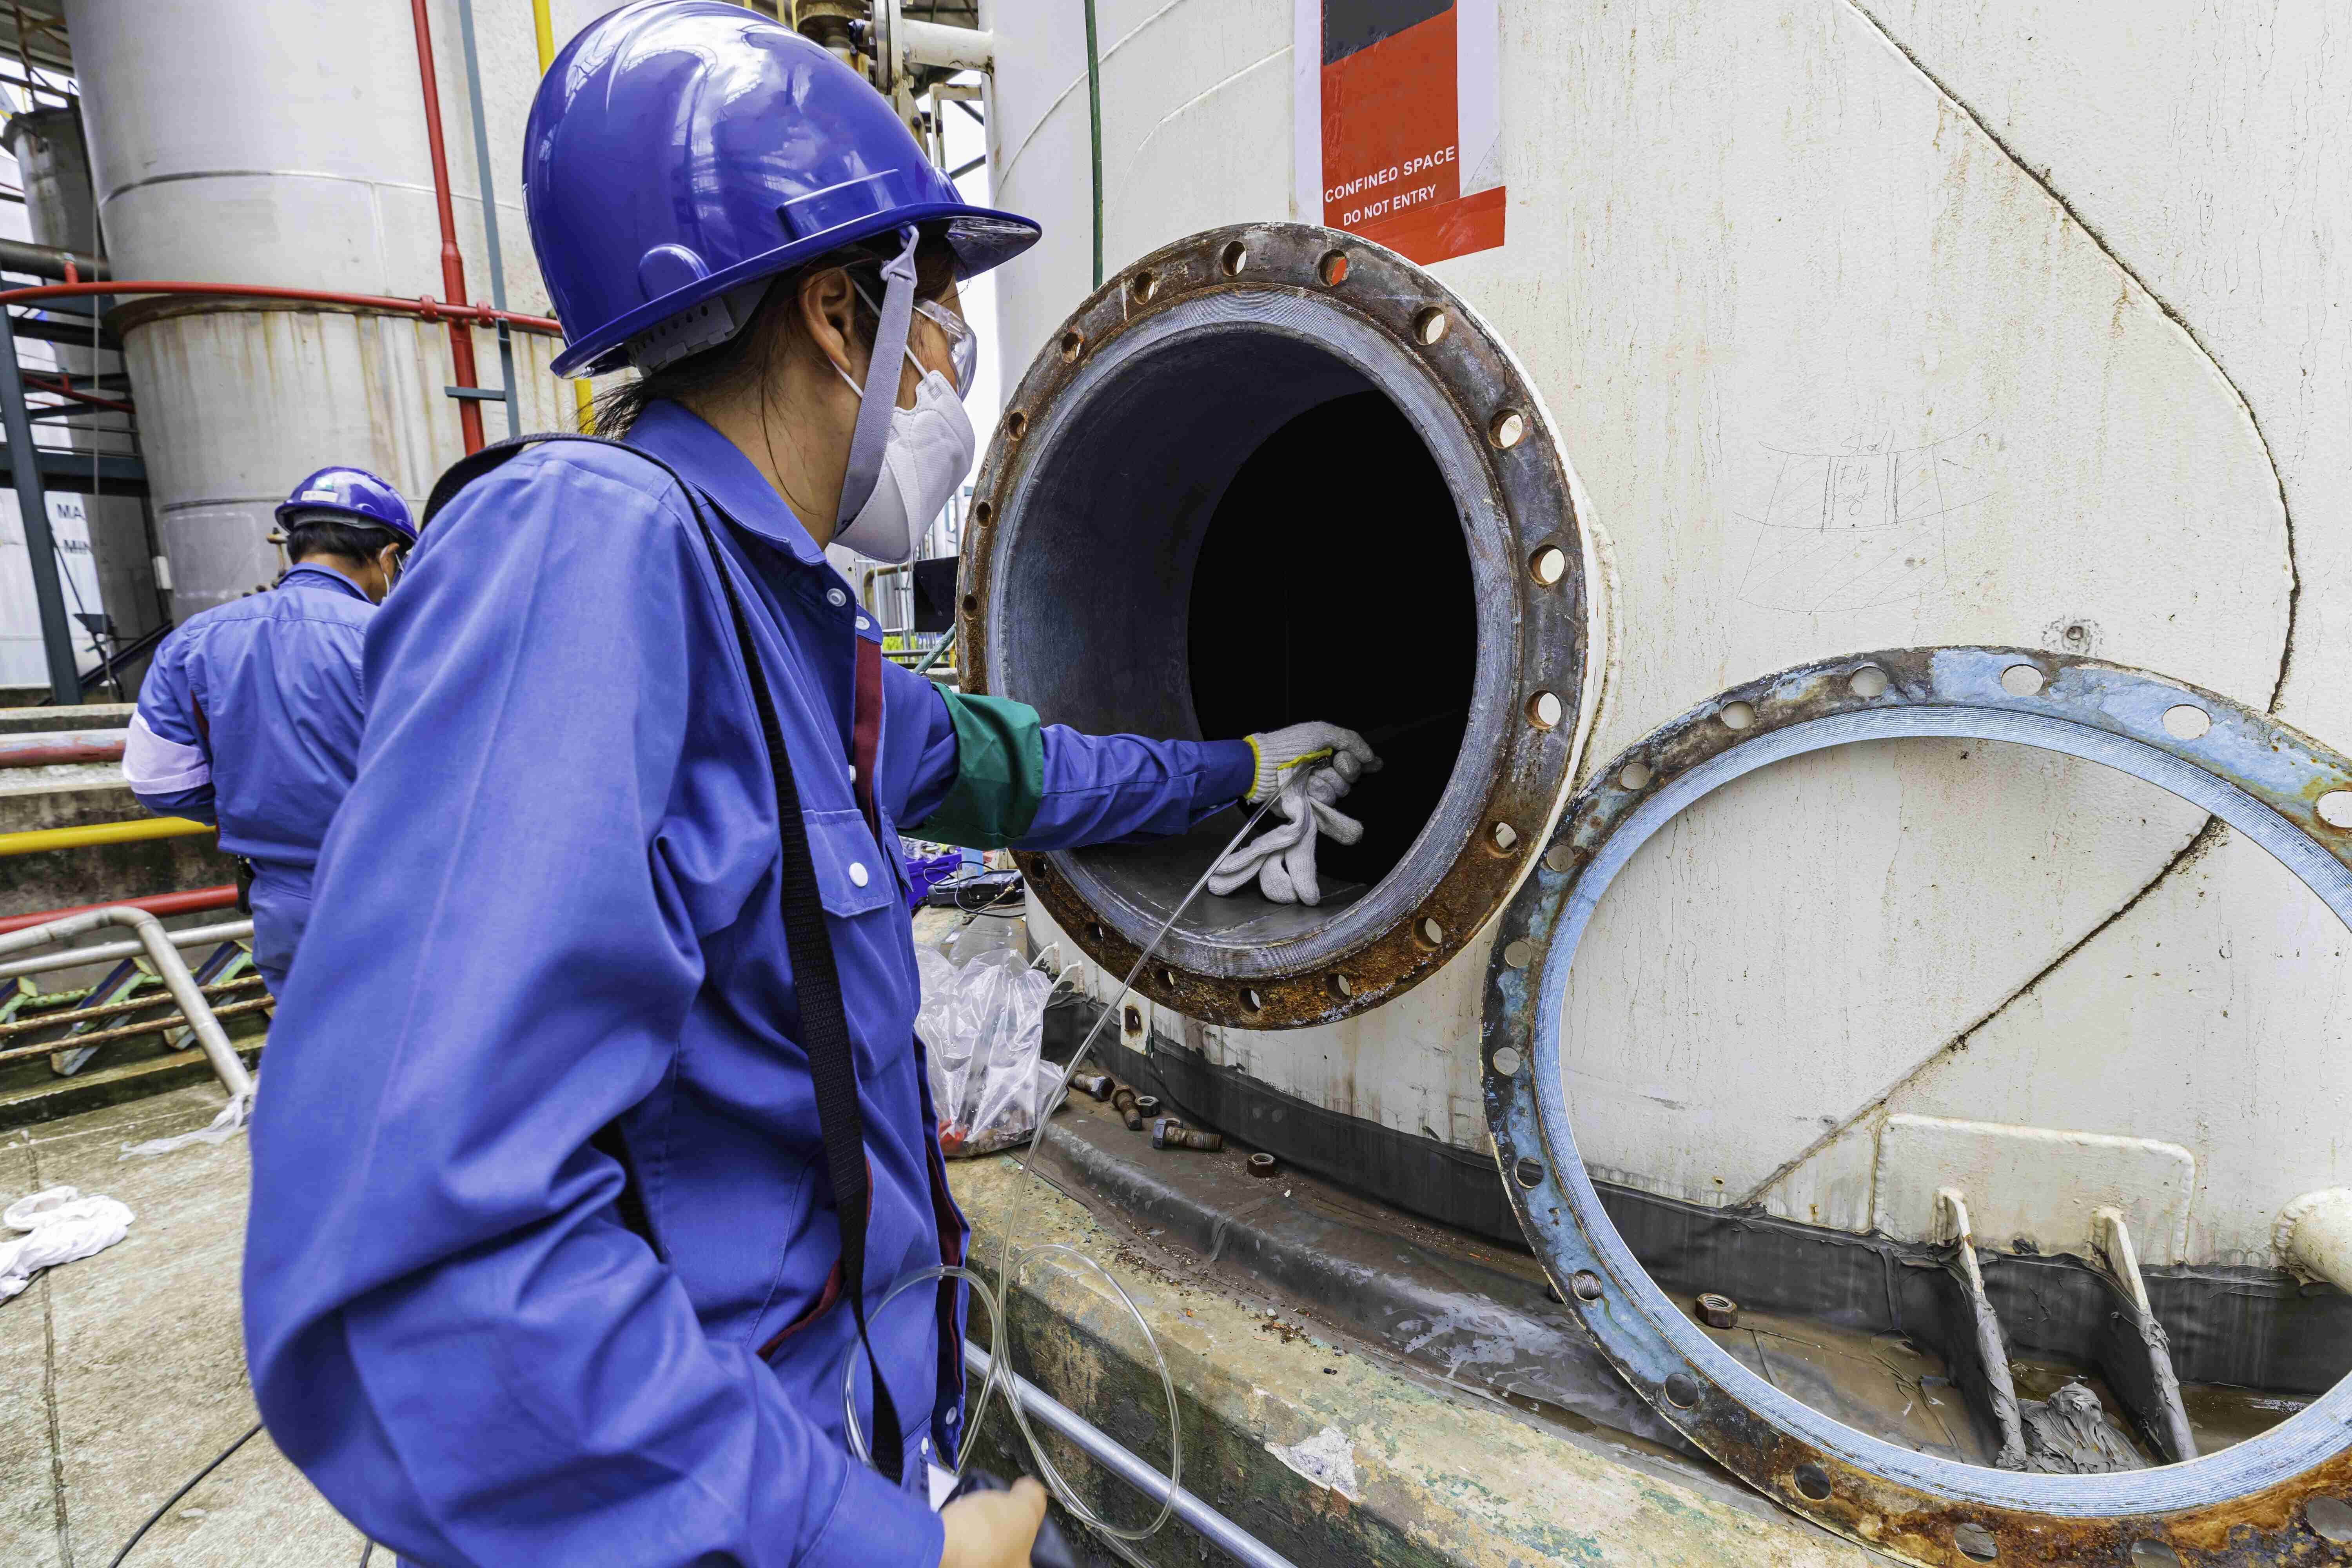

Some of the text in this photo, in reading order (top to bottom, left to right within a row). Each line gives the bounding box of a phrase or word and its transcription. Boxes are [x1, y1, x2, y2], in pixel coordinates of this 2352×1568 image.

[1325, 145, 1455, 203] CONFINED SPACE
[1343, 184, 1436, 226] DO NOT ENTRY
